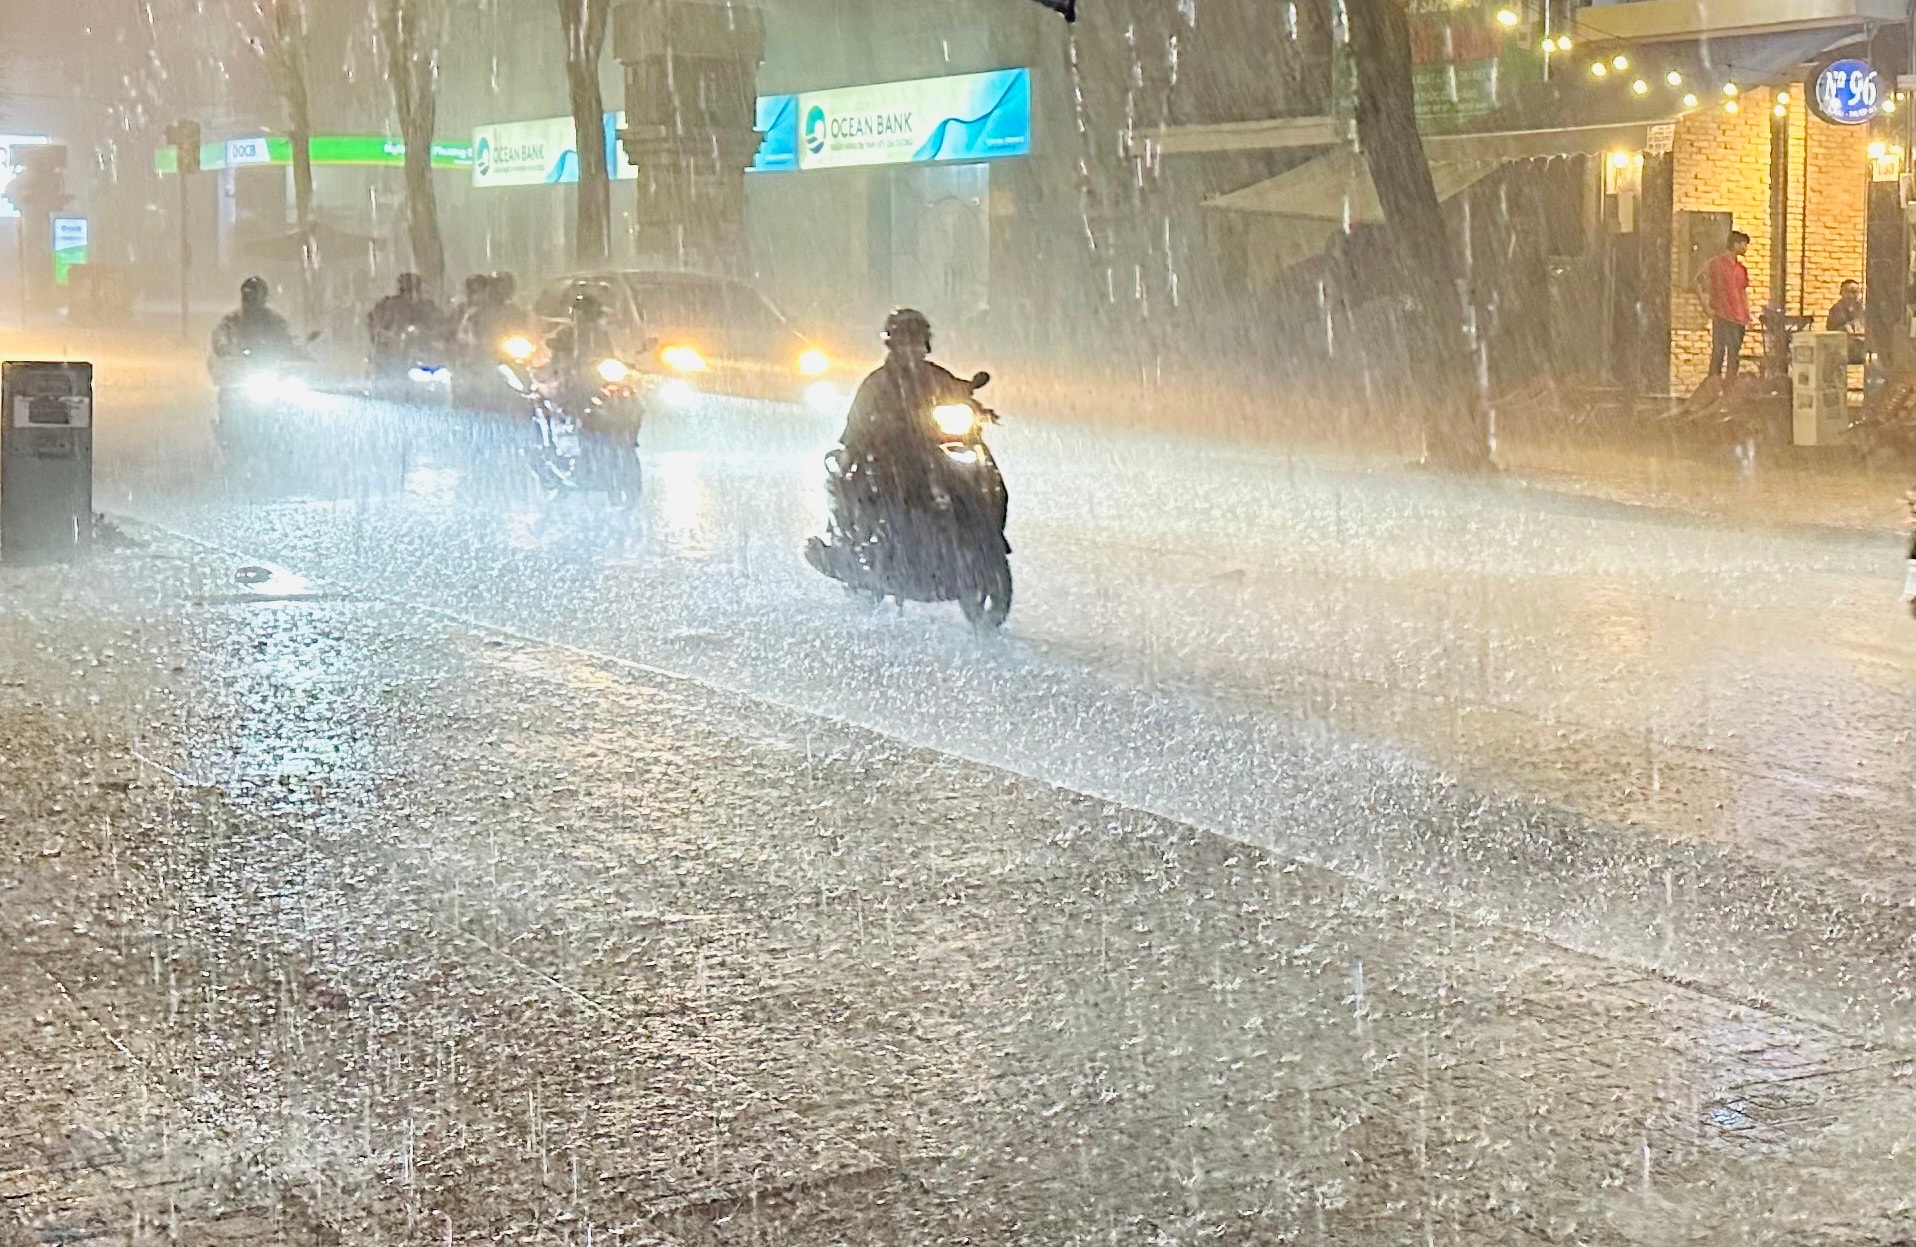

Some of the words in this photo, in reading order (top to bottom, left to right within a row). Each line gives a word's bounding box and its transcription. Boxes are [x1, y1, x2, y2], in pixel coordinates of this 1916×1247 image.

[1848, 71, 1877, 105] 96
[831, 116, 873, 138] OCEAN
[877, 111, 913, 135] BANK
[493, 146, 520, 164] OCEAN
[521, 143, 545, 162] BANK
